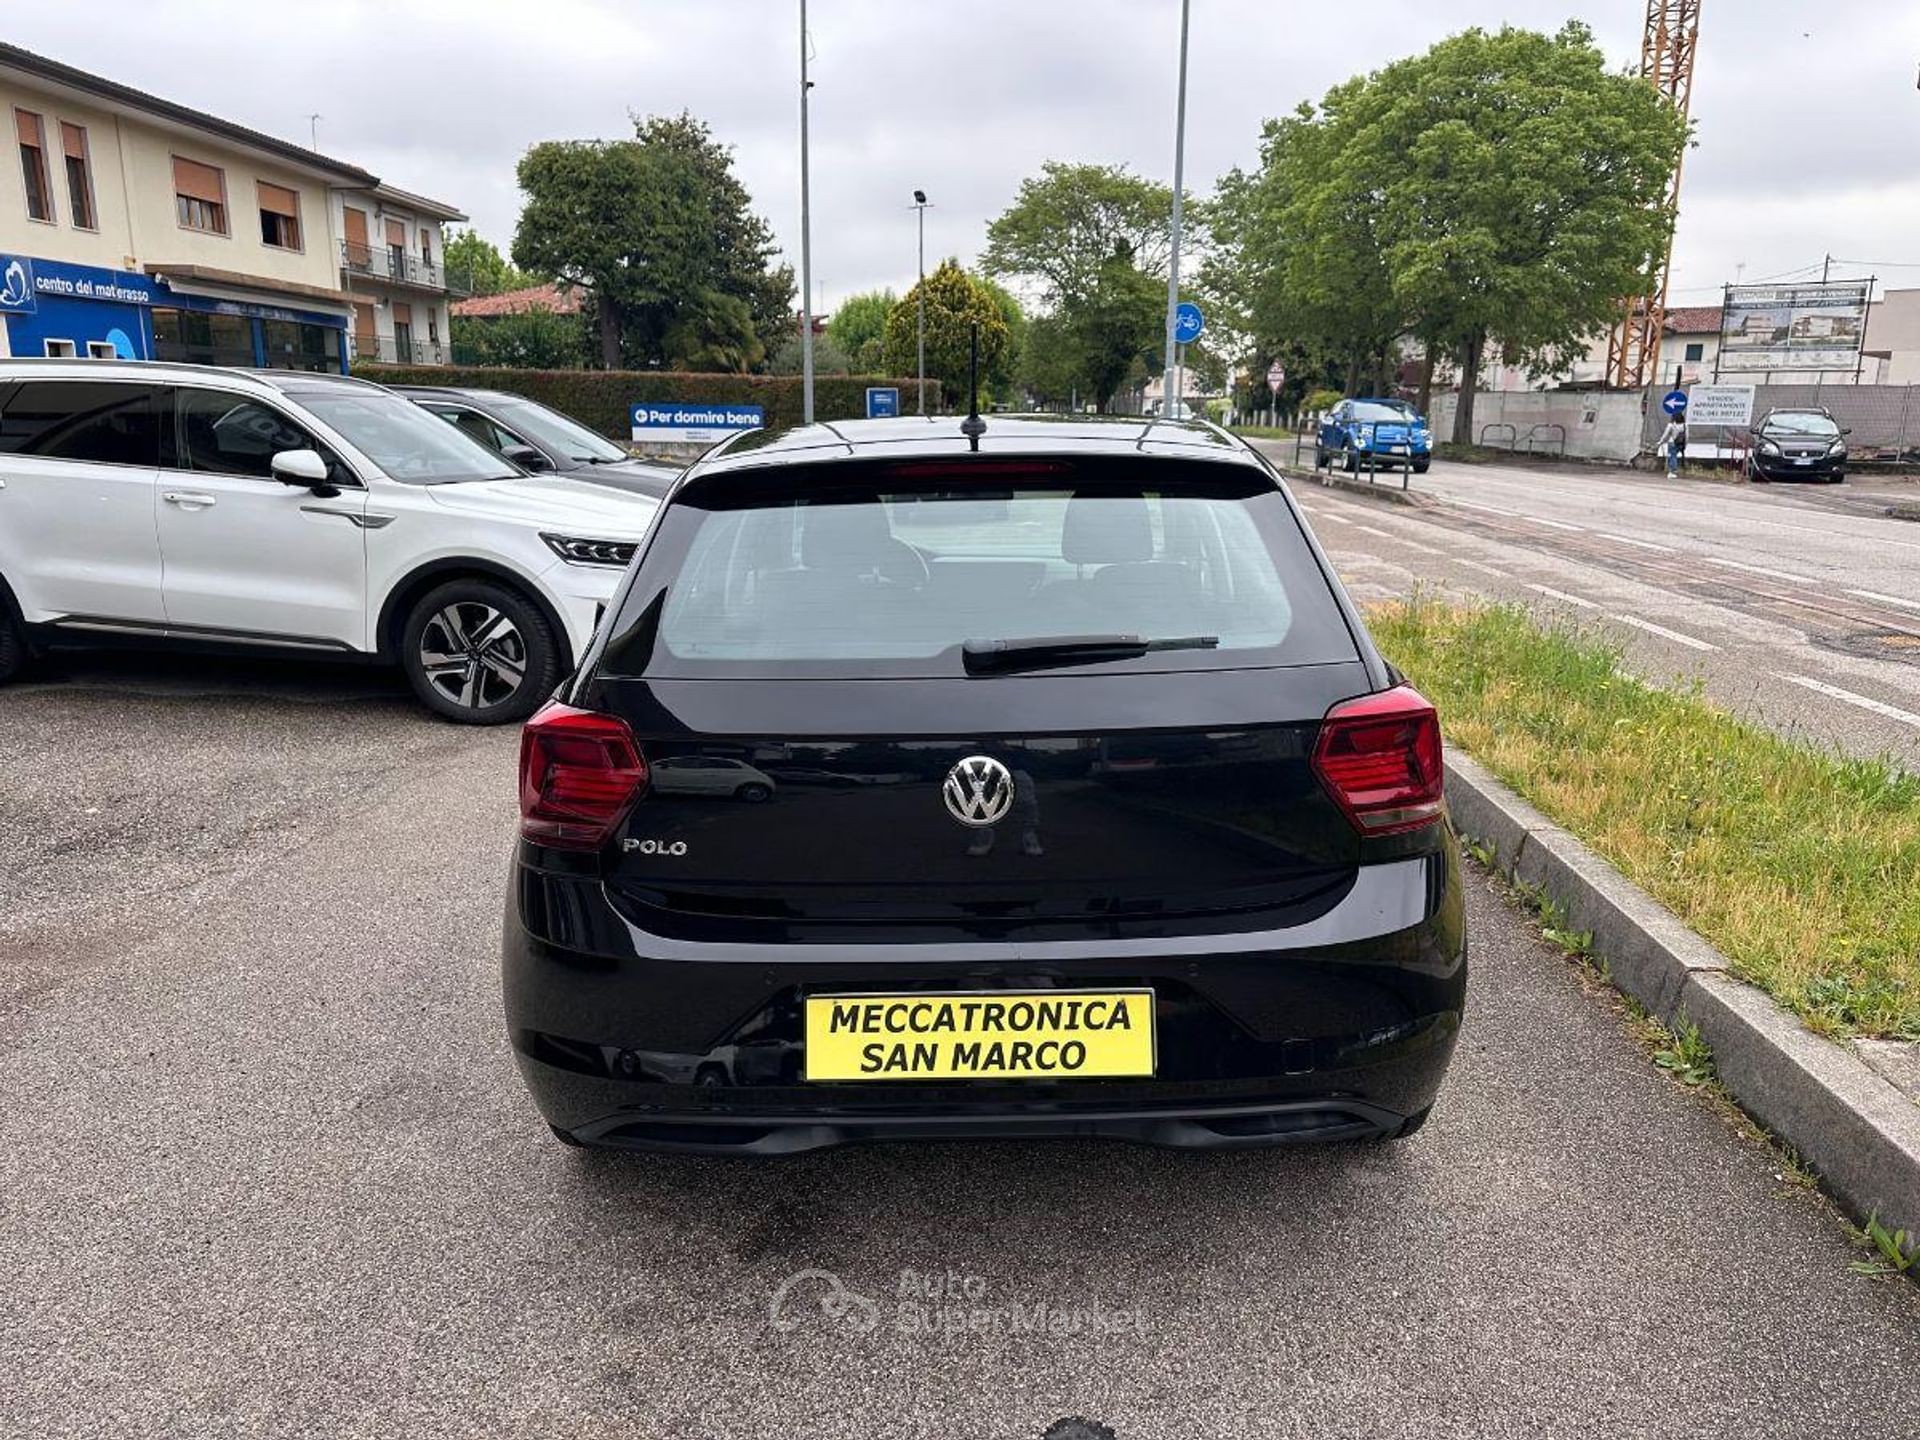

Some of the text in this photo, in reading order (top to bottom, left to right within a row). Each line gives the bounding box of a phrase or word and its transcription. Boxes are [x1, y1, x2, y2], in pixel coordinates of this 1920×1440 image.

[36, 276, 149, 302] centro del materasso
[649, 410, 760, 425] Per dormire bene
[623, 838, 688, 856] POLO
[829, 1001, 1132, 1034] MECCATRONICA
[860, 1040, 1087, 1073] SAN MARCO
